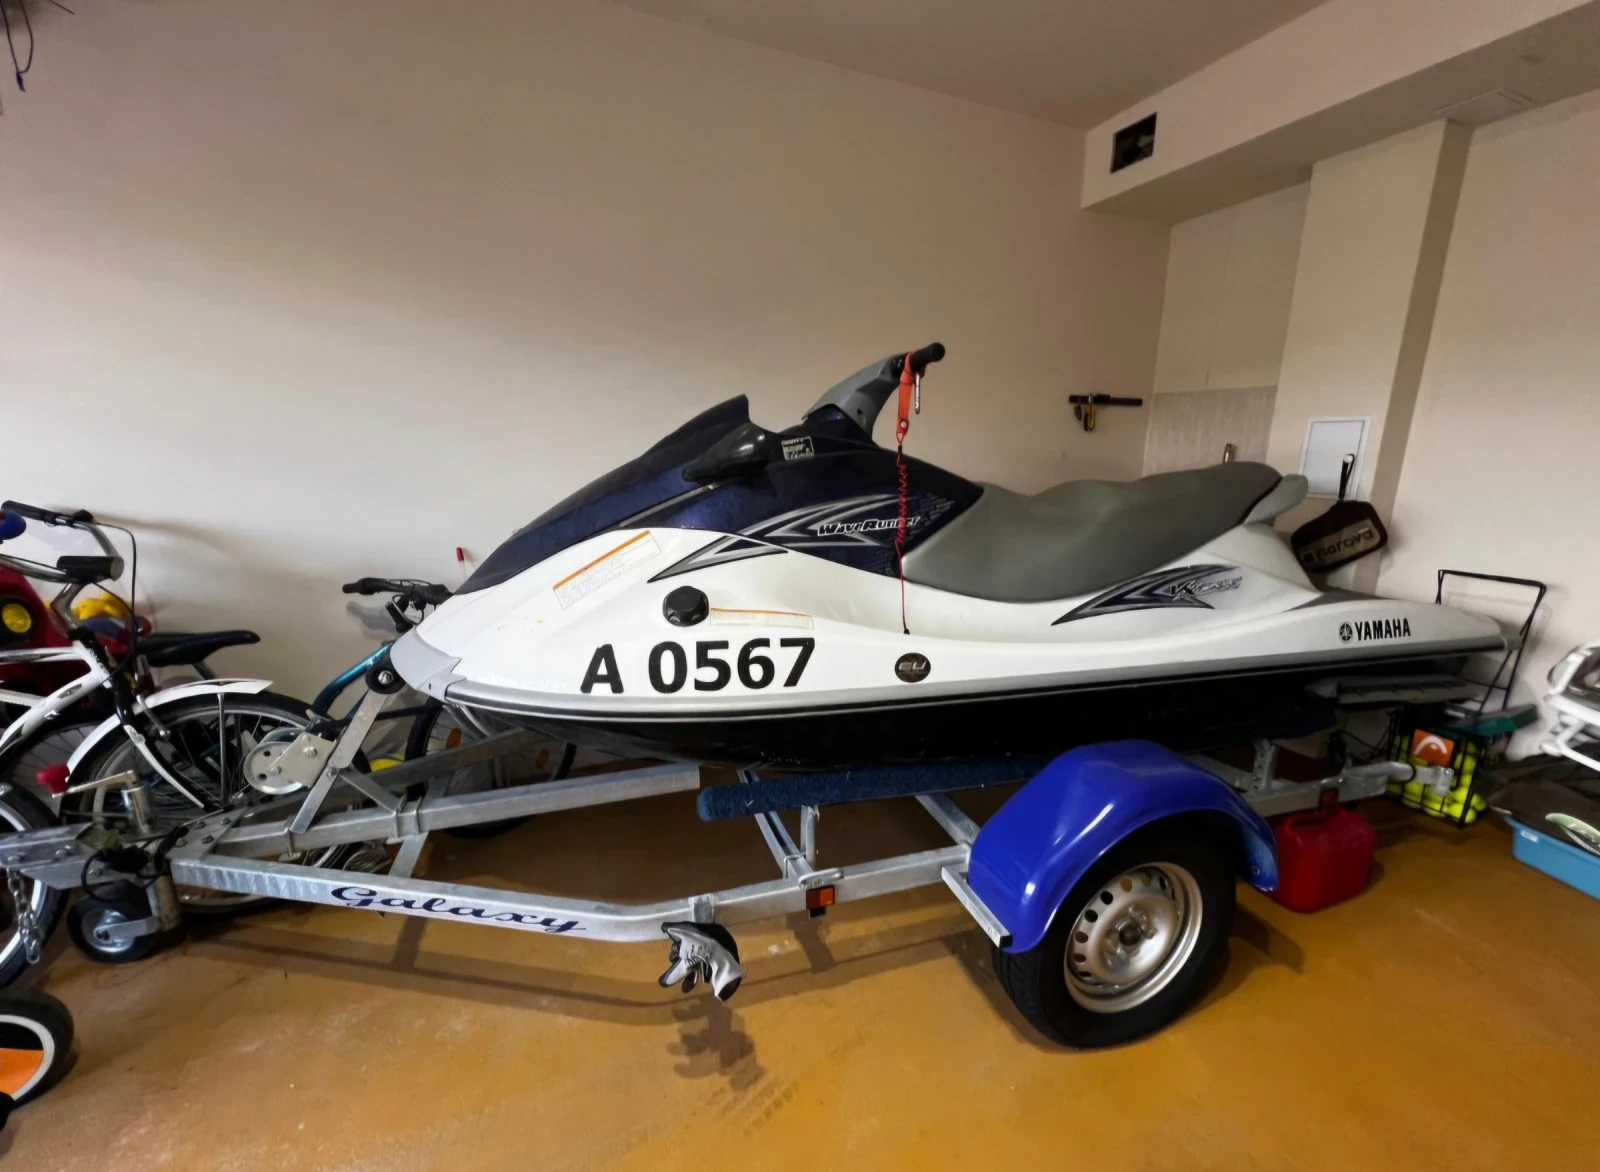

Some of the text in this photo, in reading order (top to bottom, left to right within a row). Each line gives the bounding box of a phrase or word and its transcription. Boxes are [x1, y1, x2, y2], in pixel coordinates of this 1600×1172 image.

[1354, 617, 1411, 641] YAMAHA
[580, 637, 816, 694] A 0567
[331, 886, 586, 933] Galaxy
